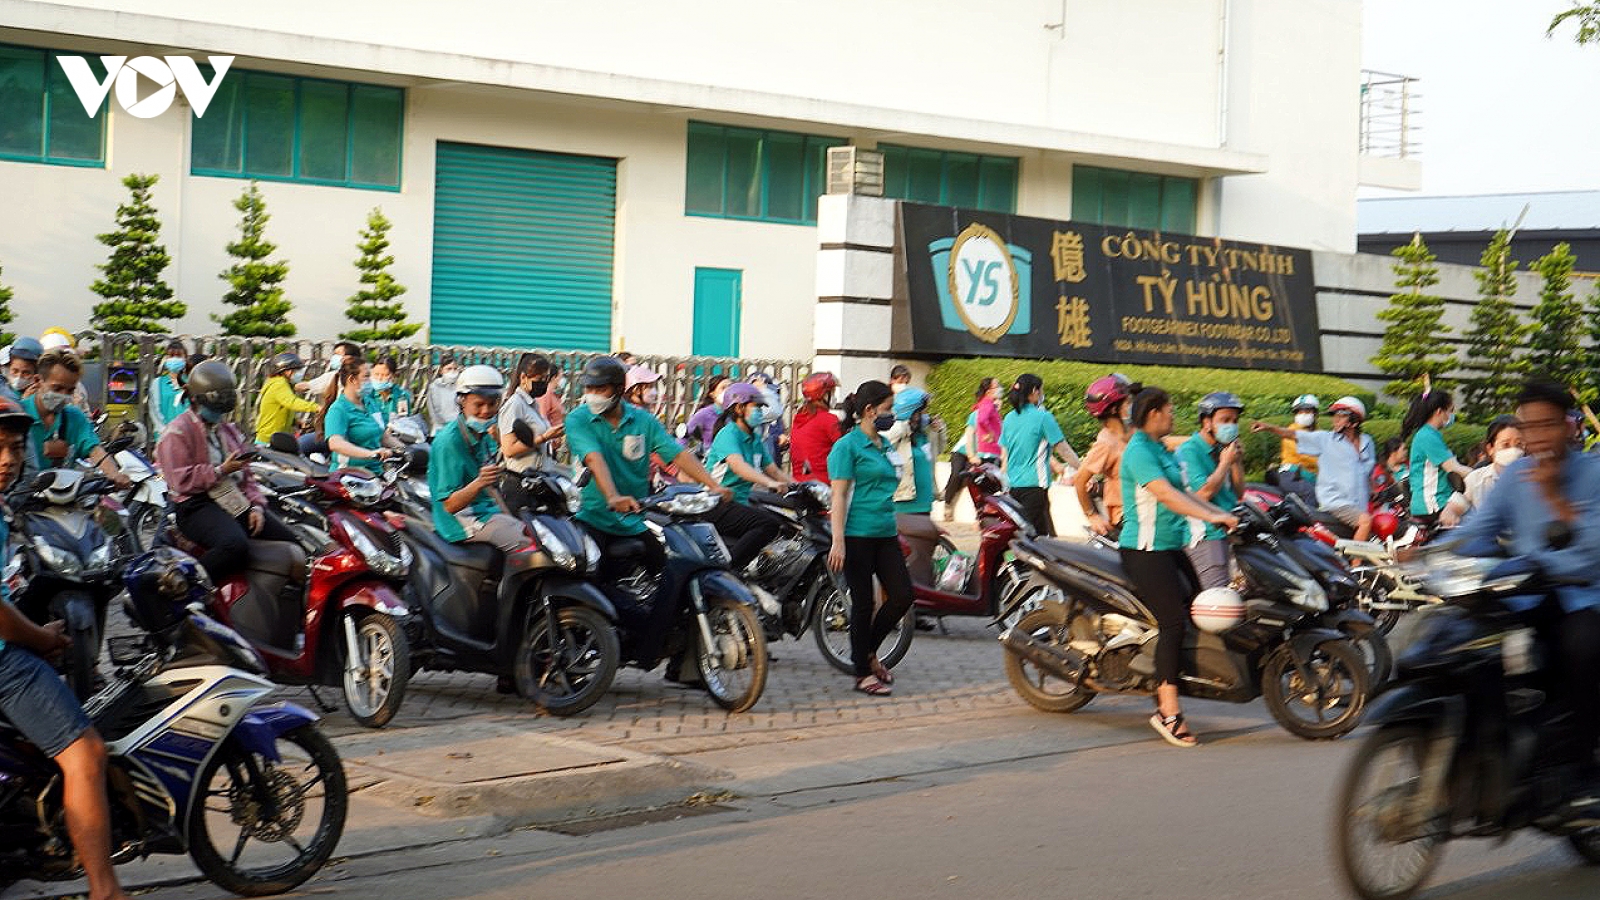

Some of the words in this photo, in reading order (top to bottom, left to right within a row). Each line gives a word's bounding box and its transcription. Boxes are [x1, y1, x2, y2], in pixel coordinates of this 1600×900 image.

[1101, 231, 1181, 265] CÔNG
[1185, 244, 1219, 267] TY
[1225, 248, 1296, 275] TNHH
[961, 258, 1002, 306] YS
[1136, 268, 1178, 314] TỶ
